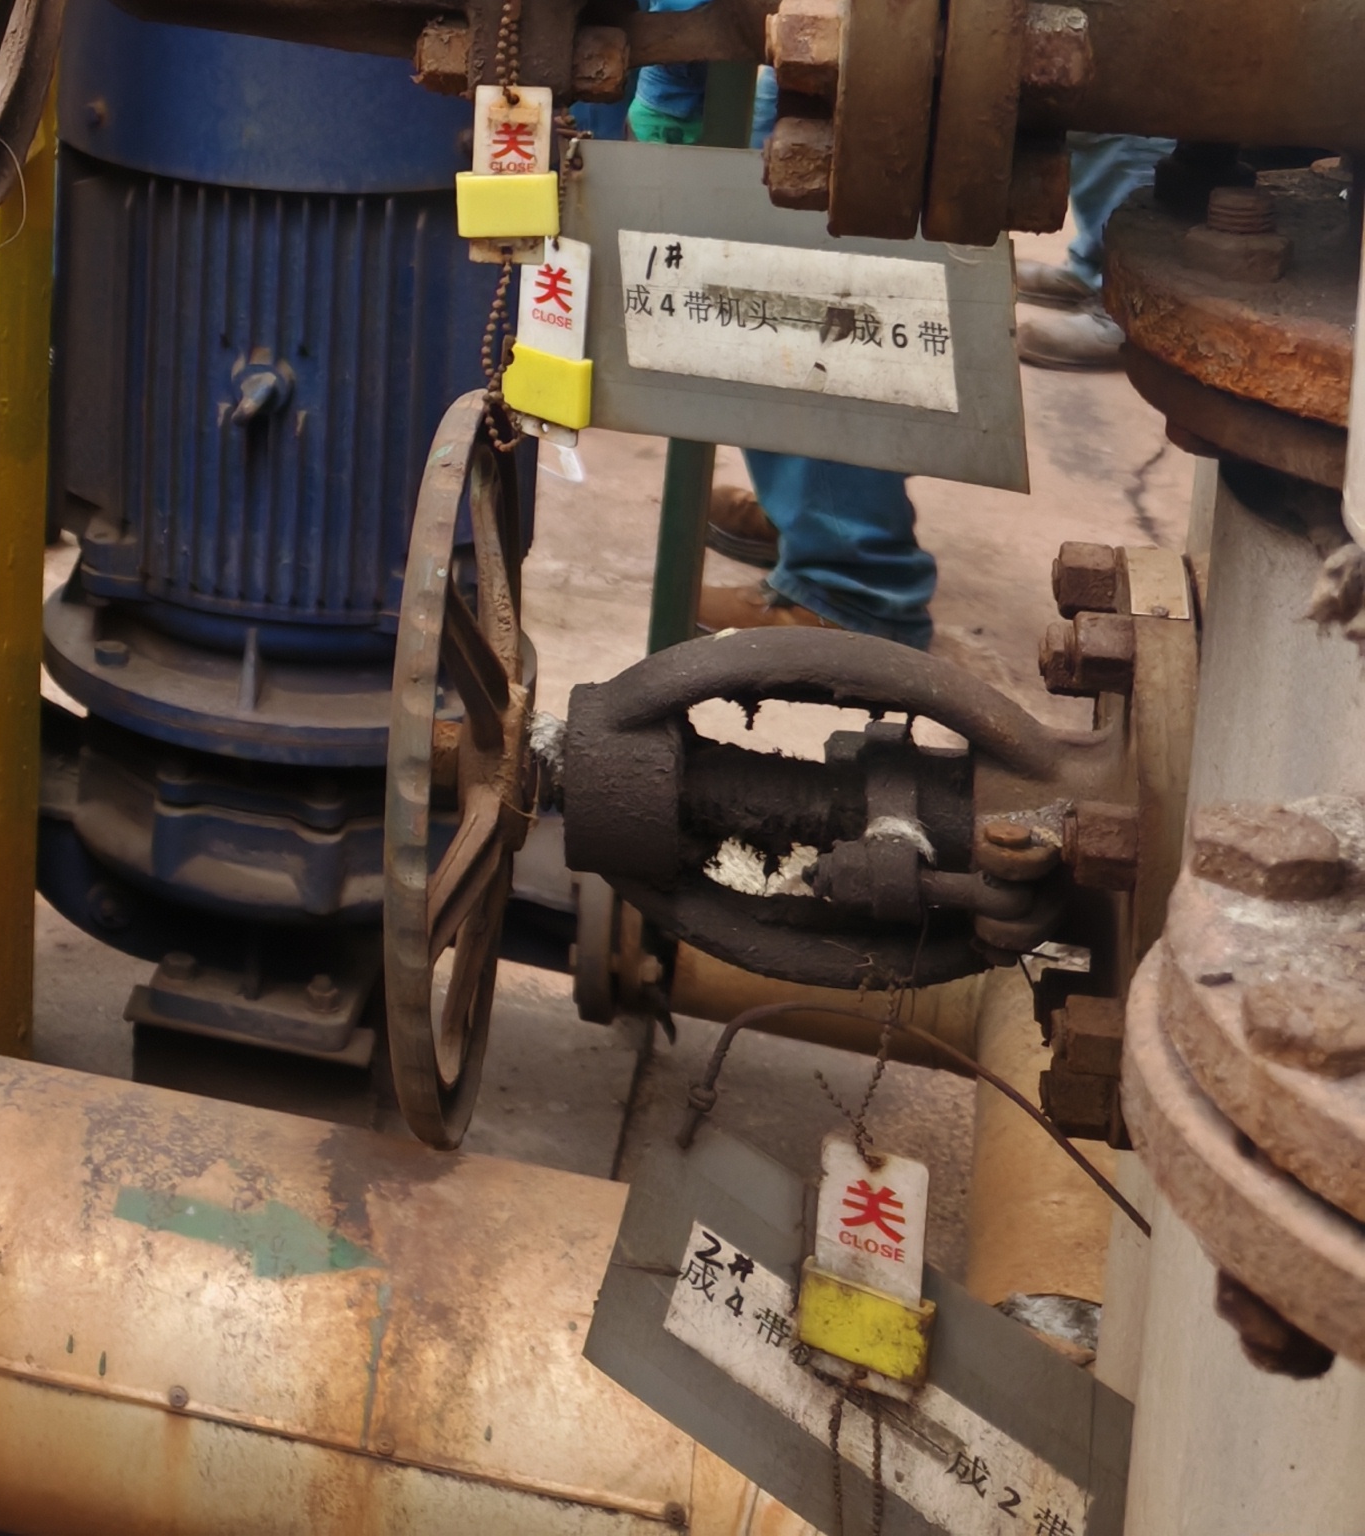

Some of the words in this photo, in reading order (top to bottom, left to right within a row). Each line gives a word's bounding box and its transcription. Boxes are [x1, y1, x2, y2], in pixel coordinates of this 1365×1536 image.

[491, 122, 536, 161] 关
[489, 160, 536, 174] CLOSE
[645, 241, 684, 280] 1#
[534, 263, 573, 314] 关
[531, 307, 573, 330] CLOSE
[839, 1179, 906, 1244] 关
[838, 1230, 906, 1263] CLOSE
